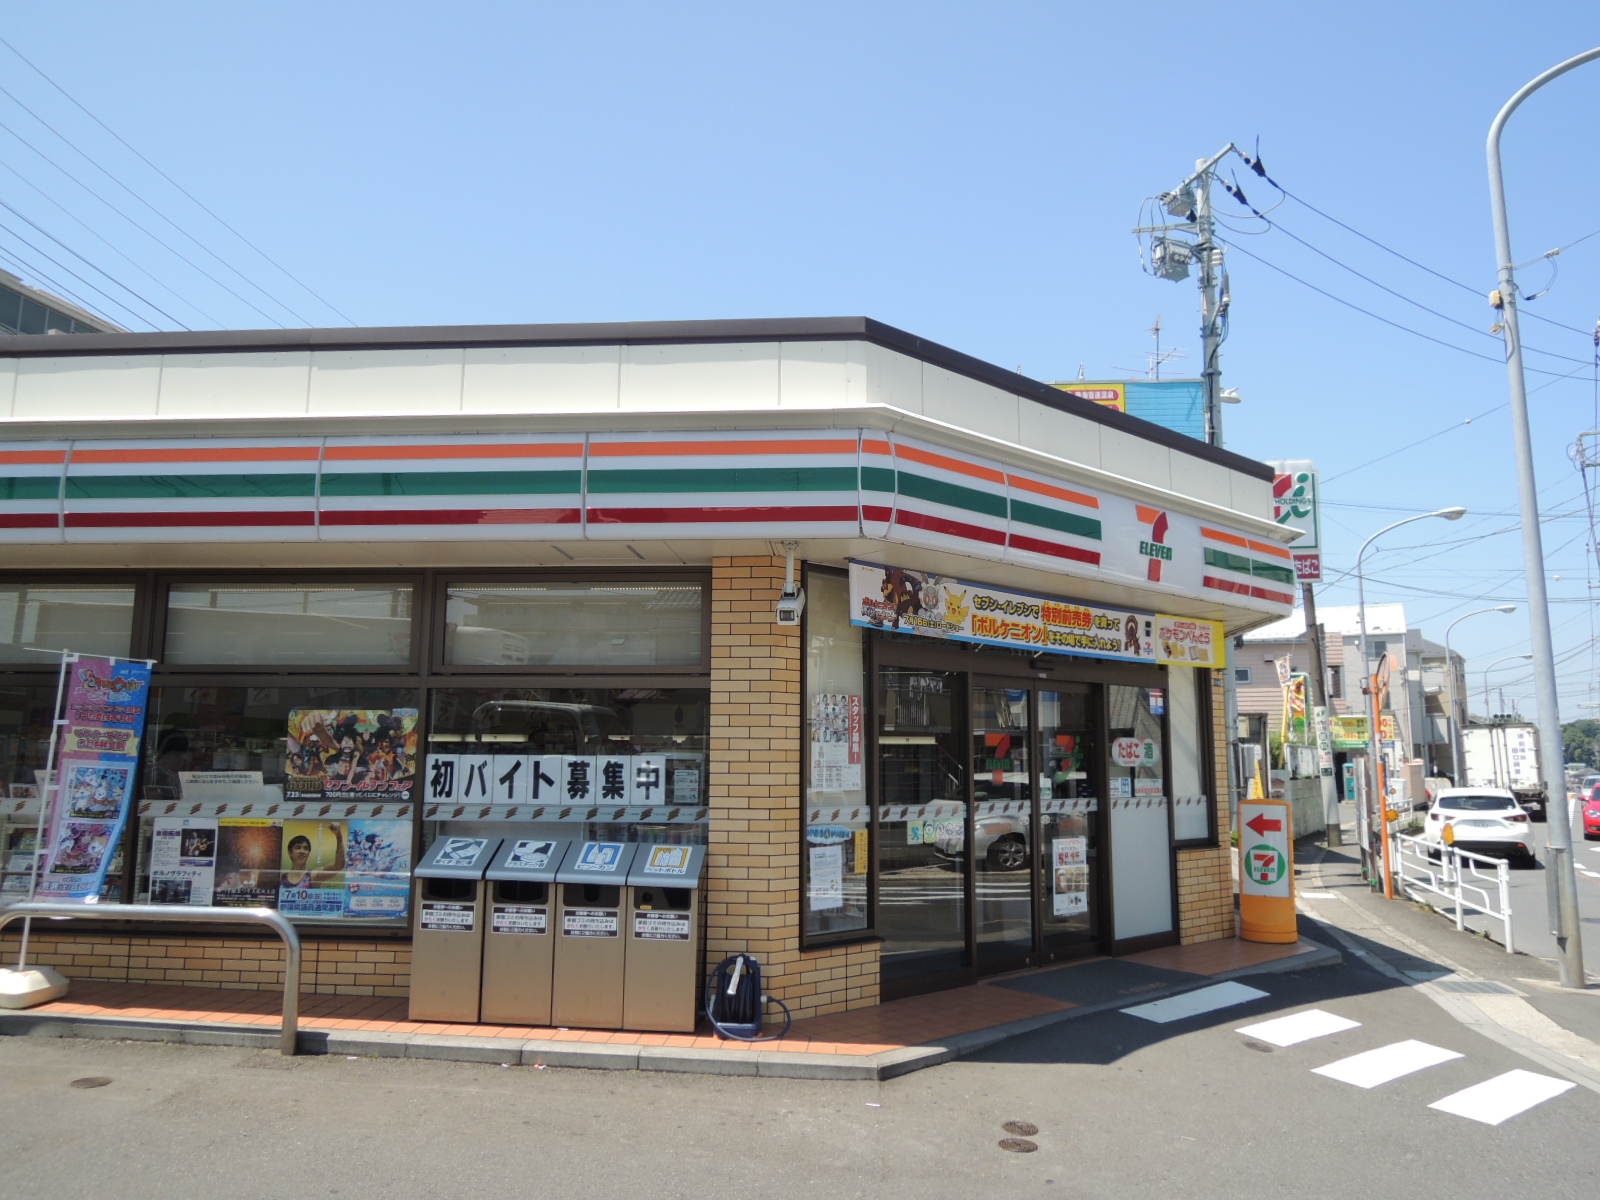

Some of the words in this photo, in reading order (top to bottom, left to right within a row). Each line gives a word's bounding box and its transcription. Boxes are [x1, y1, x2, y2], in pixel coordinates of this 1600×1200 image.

[1274, 497, 1312, 506] HOLDINGS
[1294, 558, 1319, 575] たばこ
[1117, 741, 1141, 759] たばこ
[430, 758, 660, 801] 初バイト募集中
